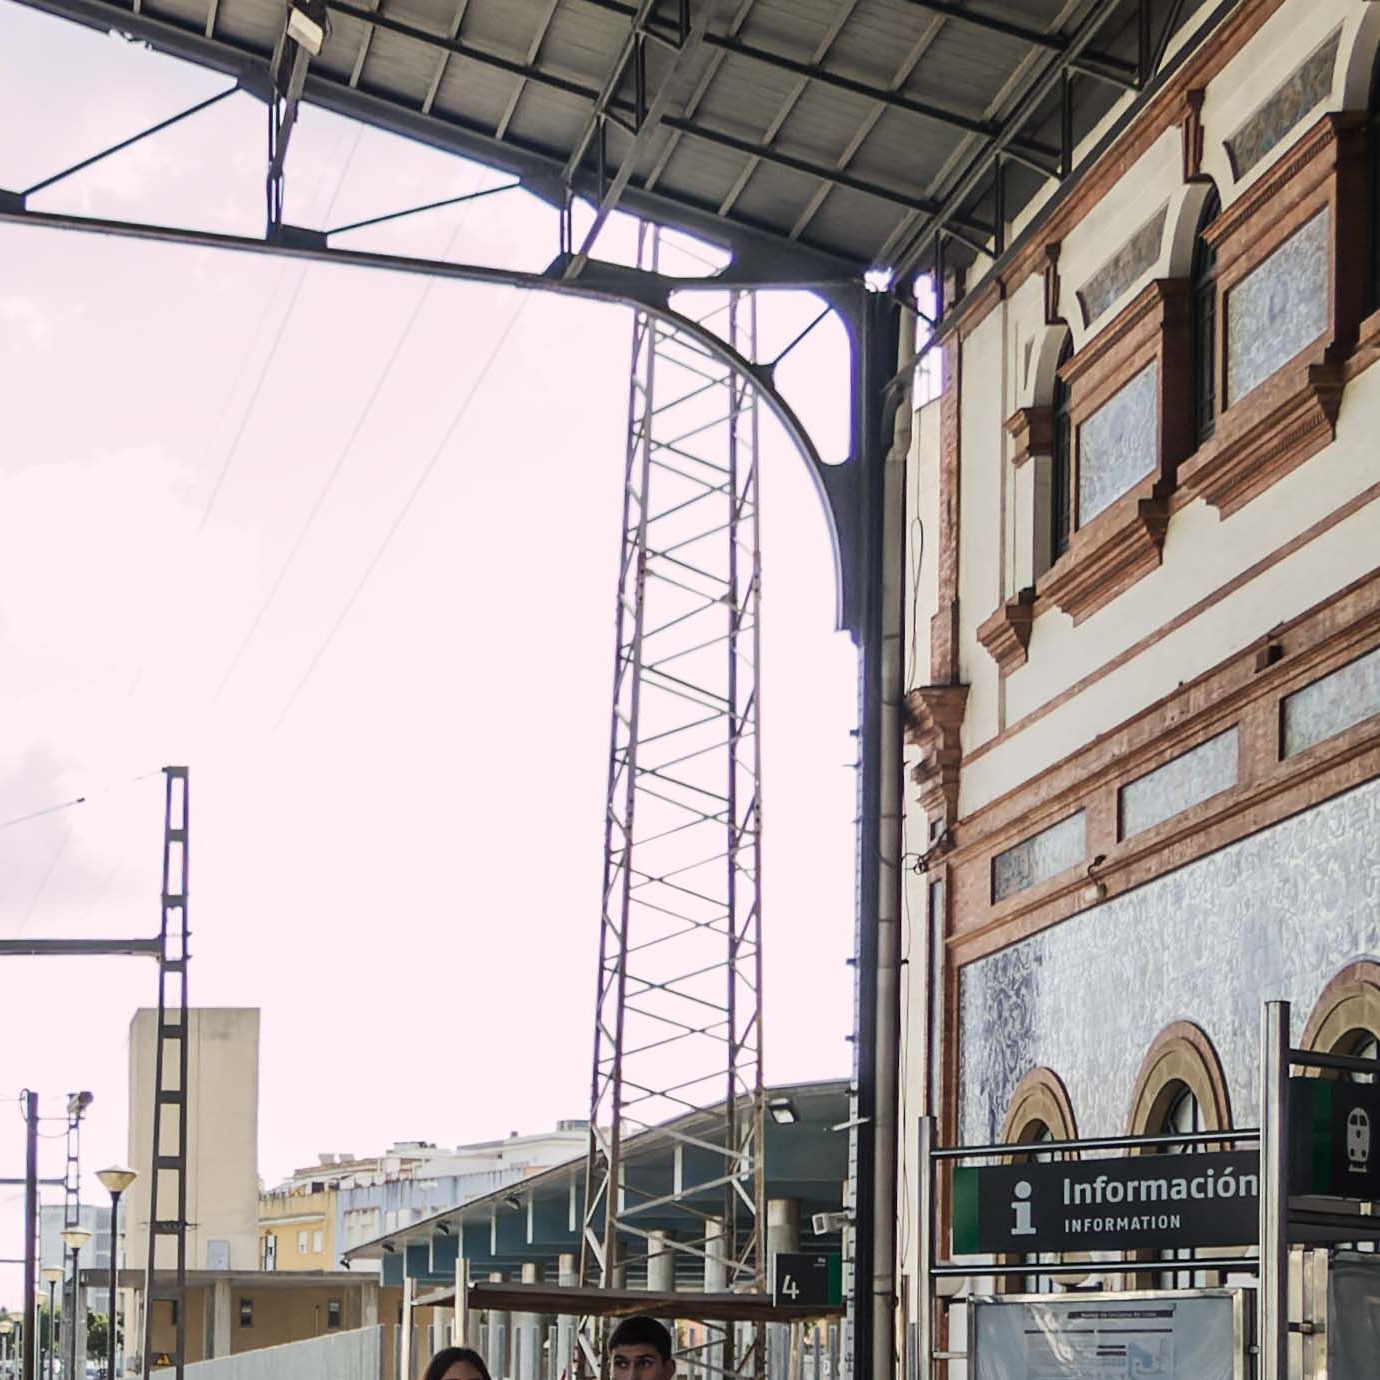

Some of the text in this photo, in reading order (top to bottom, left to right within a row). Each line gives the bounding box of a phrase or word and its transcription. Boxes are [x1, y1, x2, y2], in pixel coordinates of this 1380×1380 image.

[1062, 1166, 1258, 1205] Información
[1064, 1214, 1181, 1233] INFORMATION
[782, 1274, 800, 1300] 4
